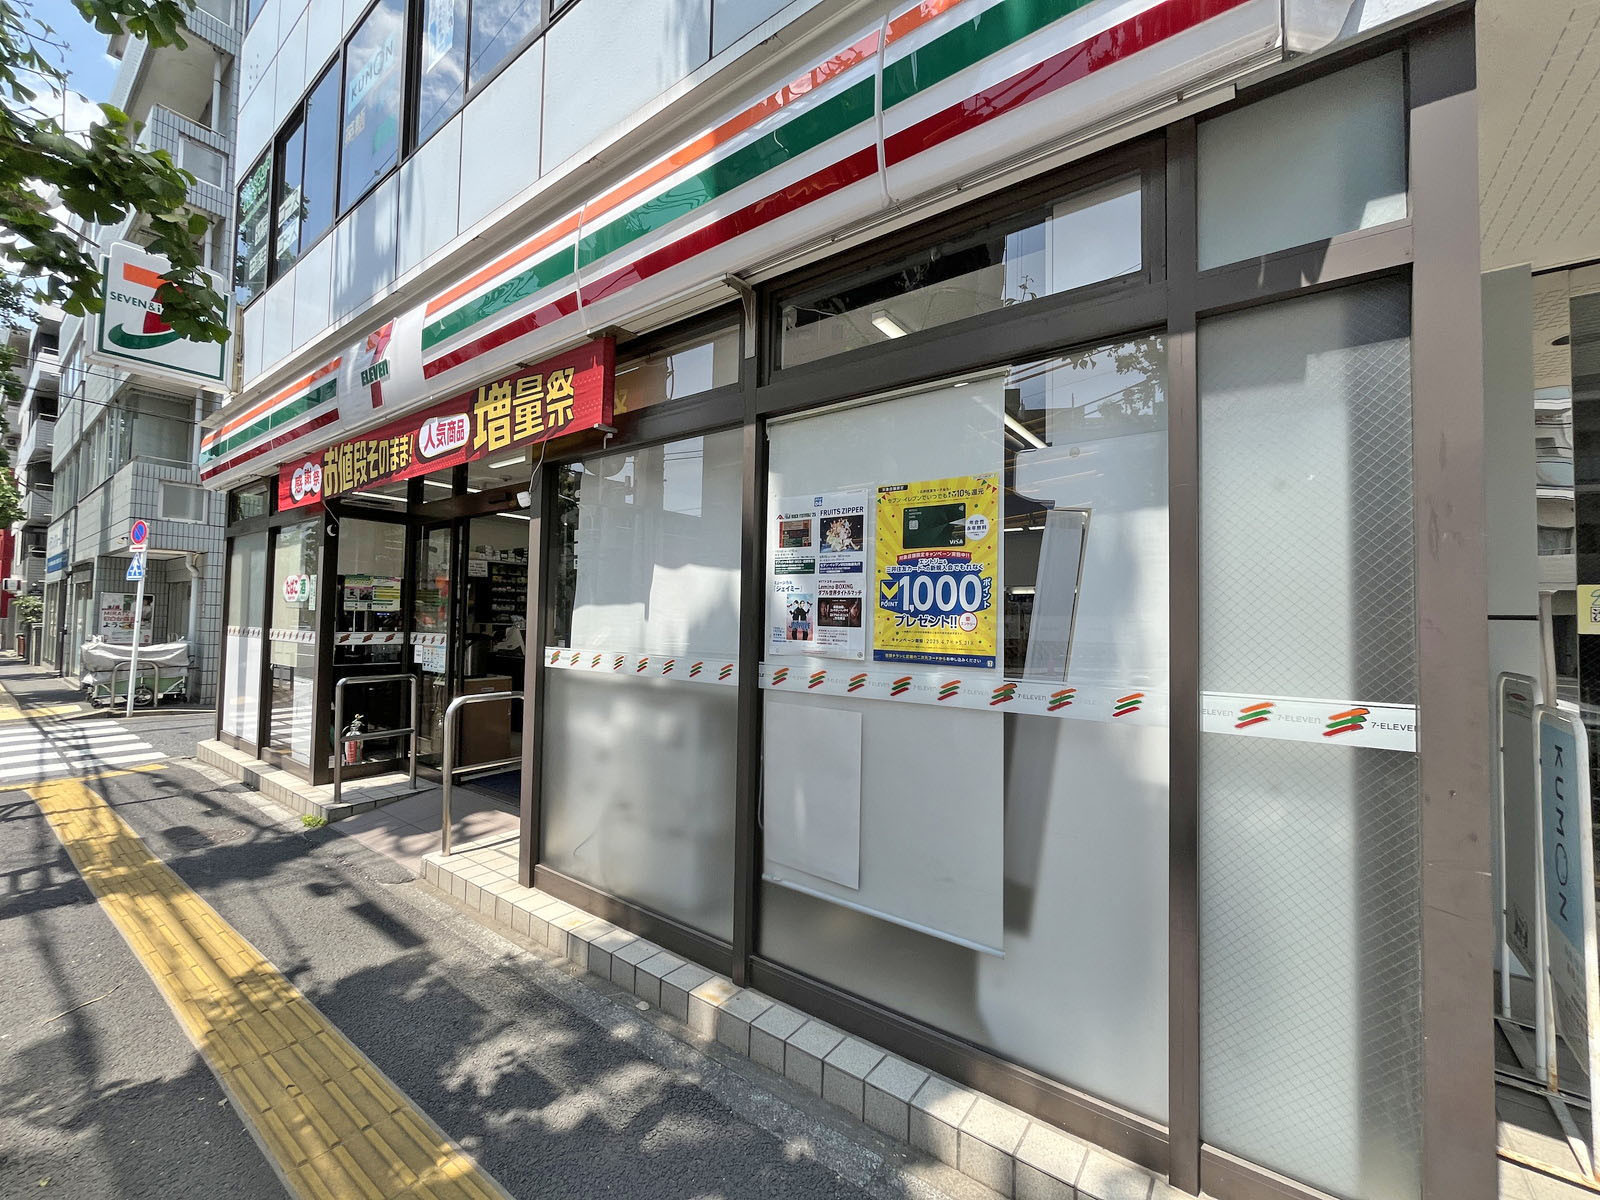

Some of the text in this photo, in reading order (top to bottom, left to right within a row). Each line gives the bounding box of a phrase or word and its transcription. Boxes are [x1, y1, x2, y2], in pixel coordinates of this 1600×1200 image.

[351, 40, 393, 101] KUMON
[473, 366, 576, 452] 増量祭
[423, 421, 466, 452] 人気商品
[324, 434, 413, 498] お値段そのまま!
[842, 506, 864, 514] ZIPPER
[899, 574, 983, 613] 1,000
[982, 577, 992, 608] ポイント
[895, 614, 957, 629] プレゼント!!
[1554, 743, 1570, 923] KUMON
